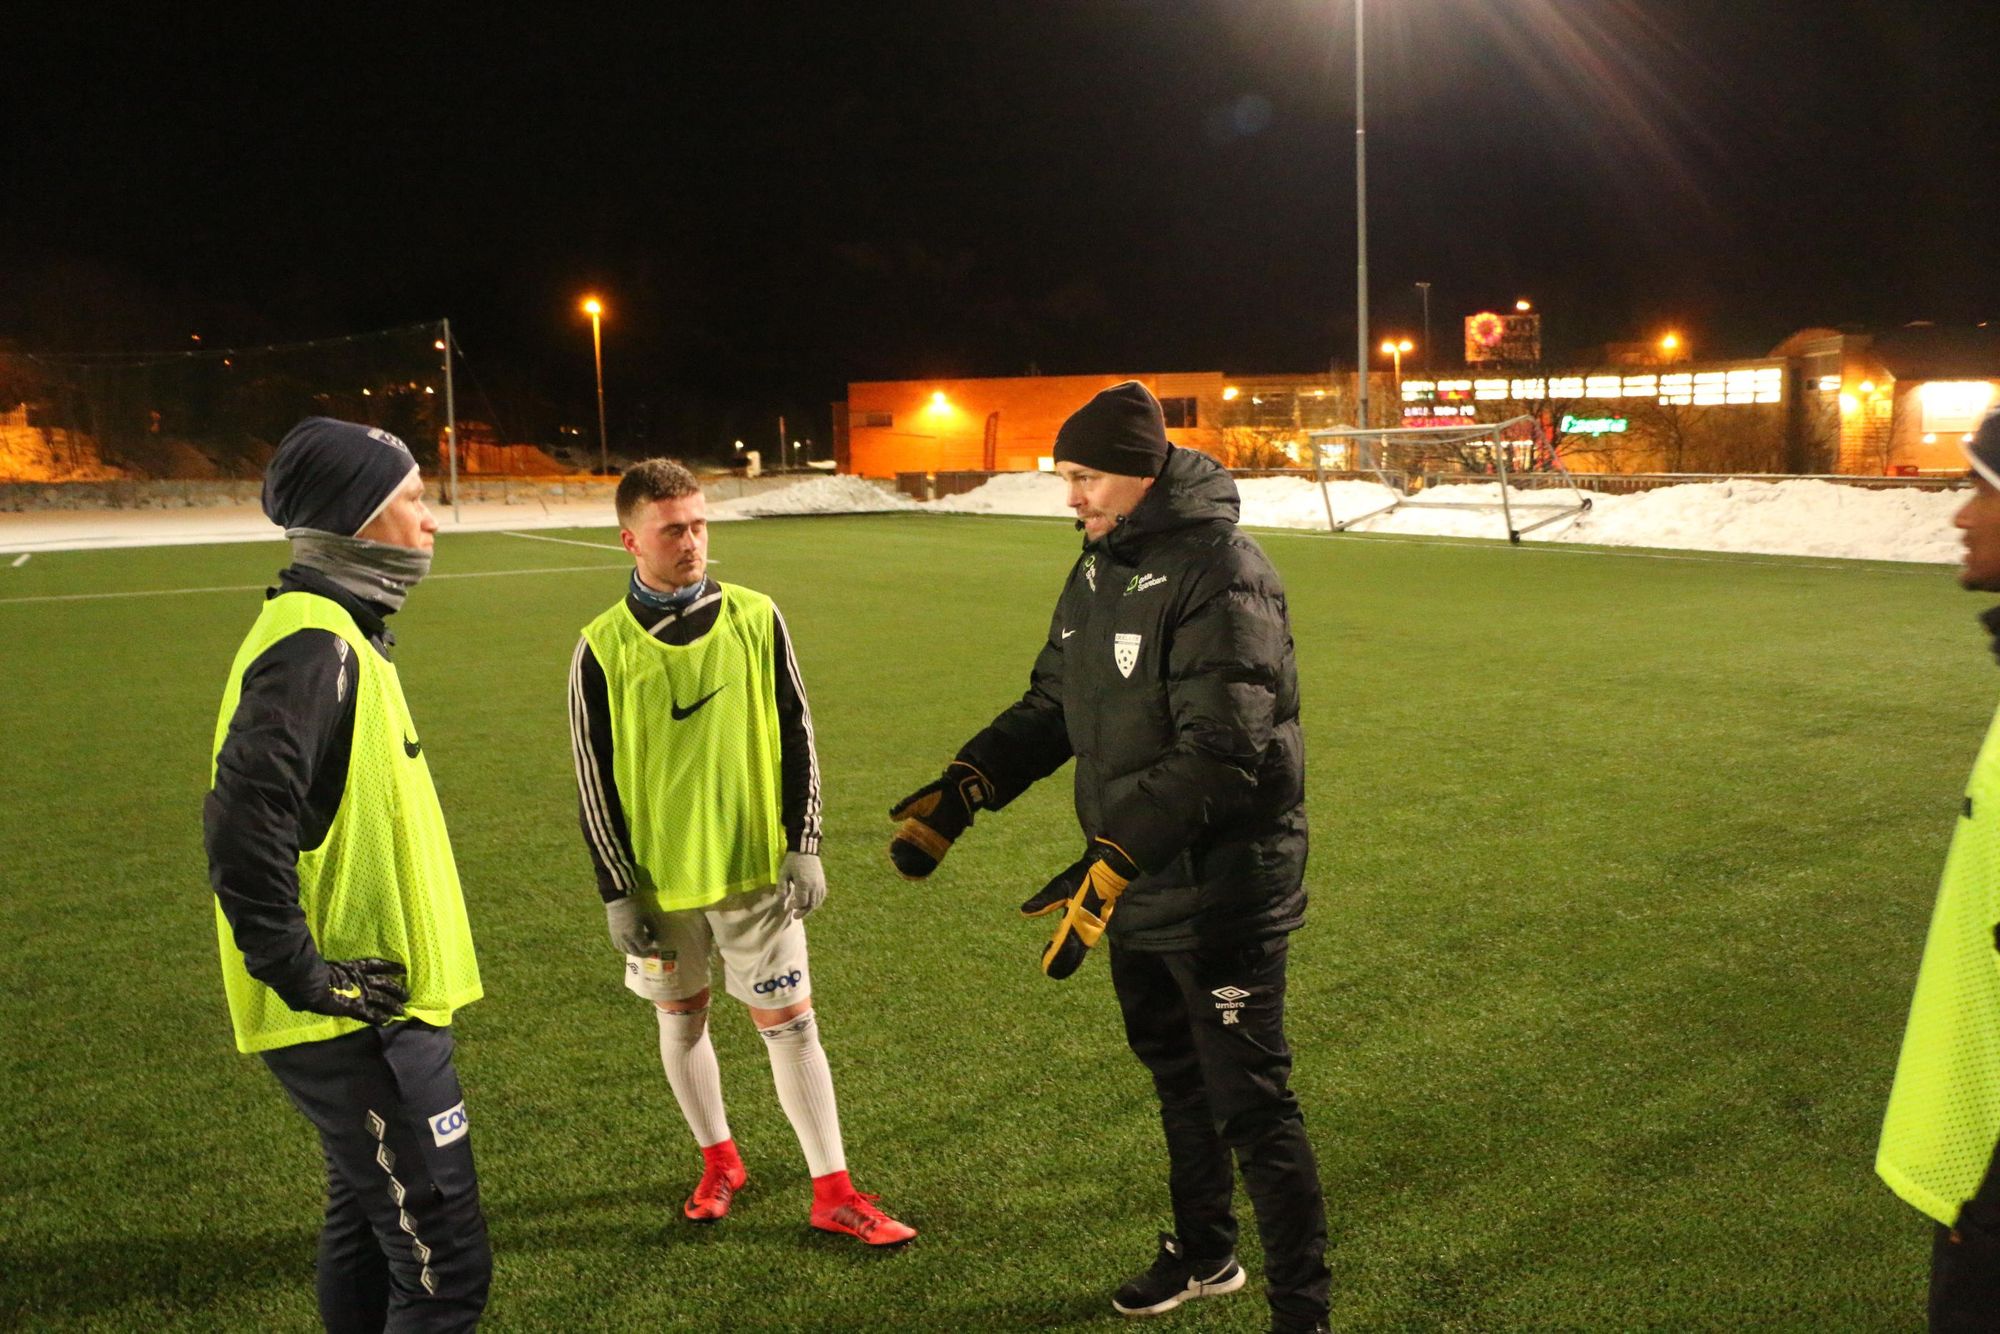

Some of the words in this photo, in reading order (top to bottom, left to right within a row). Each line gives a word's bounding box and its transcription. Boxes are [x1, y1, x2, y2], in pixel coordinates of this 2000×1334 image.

[753, 970, 801, 994] coop
[1215, 1001, 1245, 1009] umbro
[1222, 1010, 1240, 1025] SK
